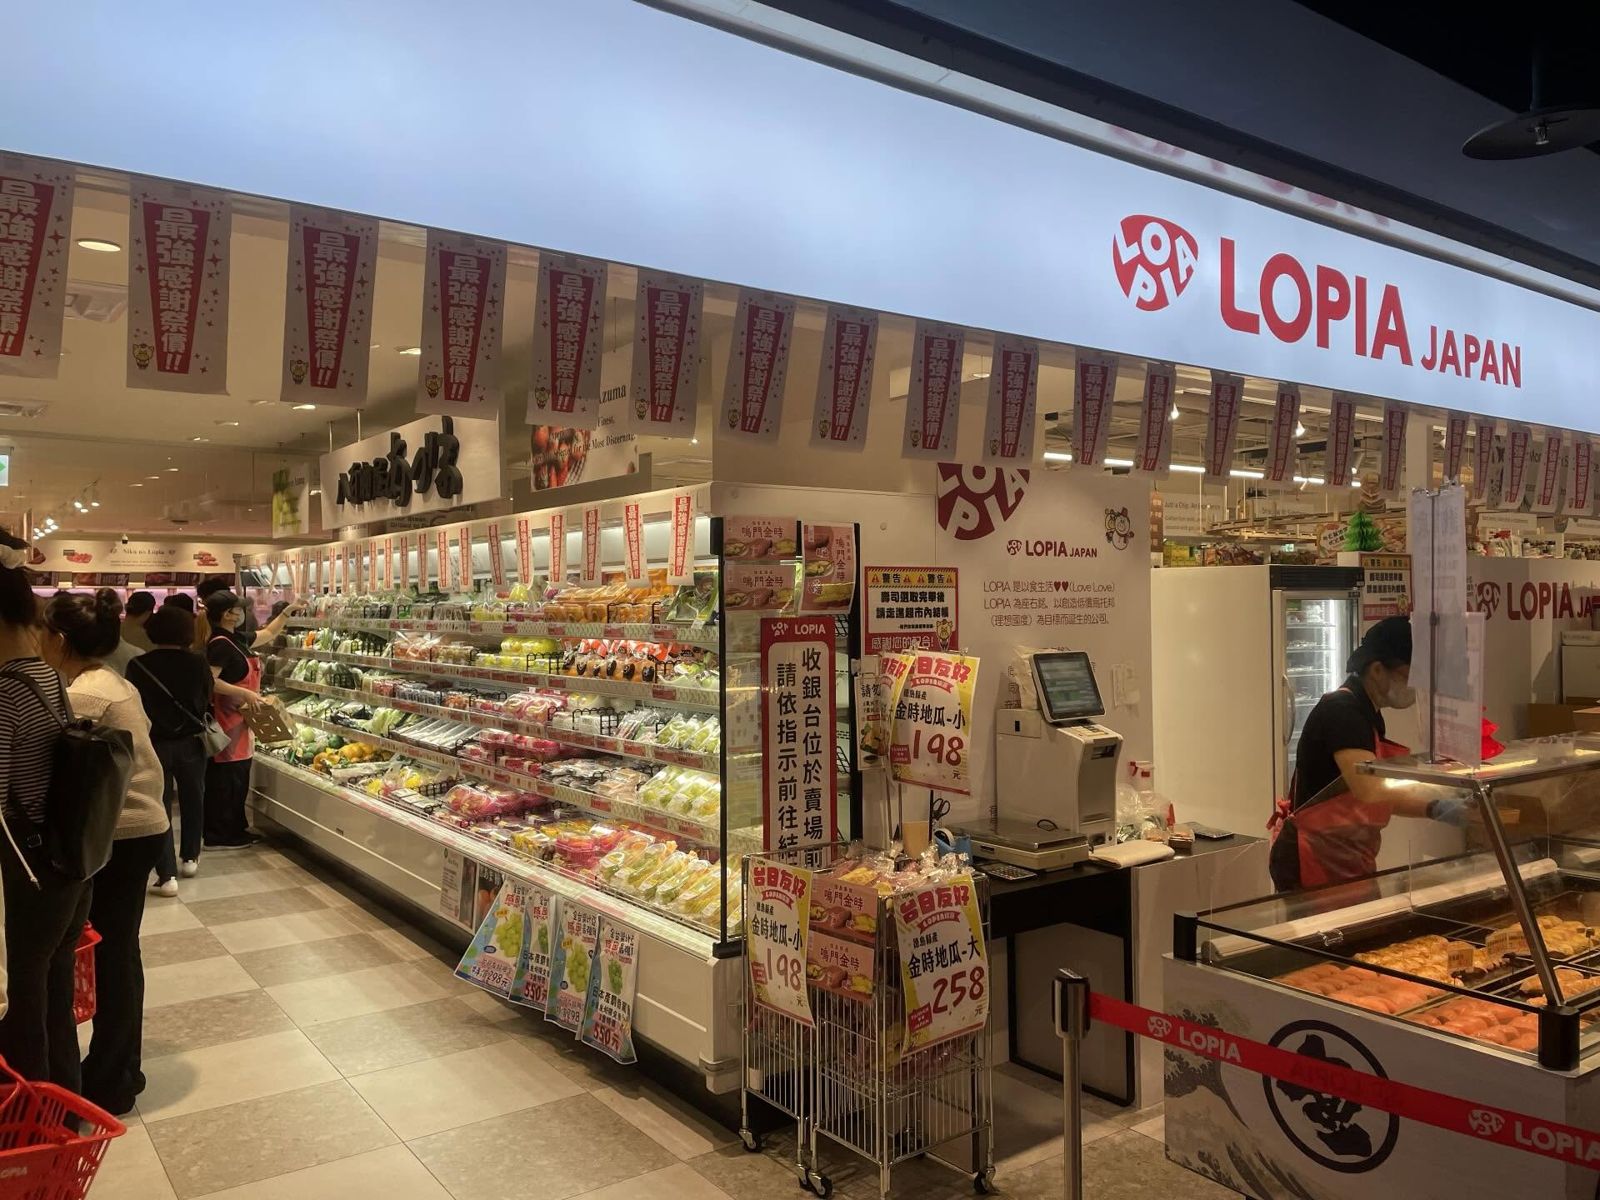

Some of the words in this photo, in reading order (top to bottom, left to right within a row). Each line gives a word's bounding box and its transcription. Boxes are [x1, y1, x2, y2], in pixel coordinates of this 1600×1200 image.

[1219, 236, 1413, 366] LOPIA
[1420, 325, 1522, 388] JAPAN
[600, 385, 626, 404] zuma
[1025, 540, 1068, 558] LOPIA
[1069, 548, 1098, 558] JAPAN
[882, 573, 901, 584] 警告
[927, 573, 945, 584] 警告
[983, 581, 1011, 592] LOPIA
[984, 598, 1011, 610] LOPIA
[1507, 581, 1574, 621] LOPIA
[794, 624, 826, 635] LOPIA
[908, 656, 972, 683] 日友好
[894, 700, 966, 729] 金時地瓜-小
[802, 648, 823, 869] 收銀台位於賣場前
[913, 729, 964, 766] 198
[952, 769, 961, 780] 元
[753, 866, 806, 898] 台日友好
[900, 885, 970, 924] 台日友好
[751, 914, 803, 951] 金時地瓜-小
[766, 948, 802, 991] 198
[907, 936, 981, 980] 金時地瓜-大
[932, 966, 984, 1014] 258
[1178, 1026, 1243, 1063] LOPIA
[1514, 1120, 1600, 1163] LOPIA
